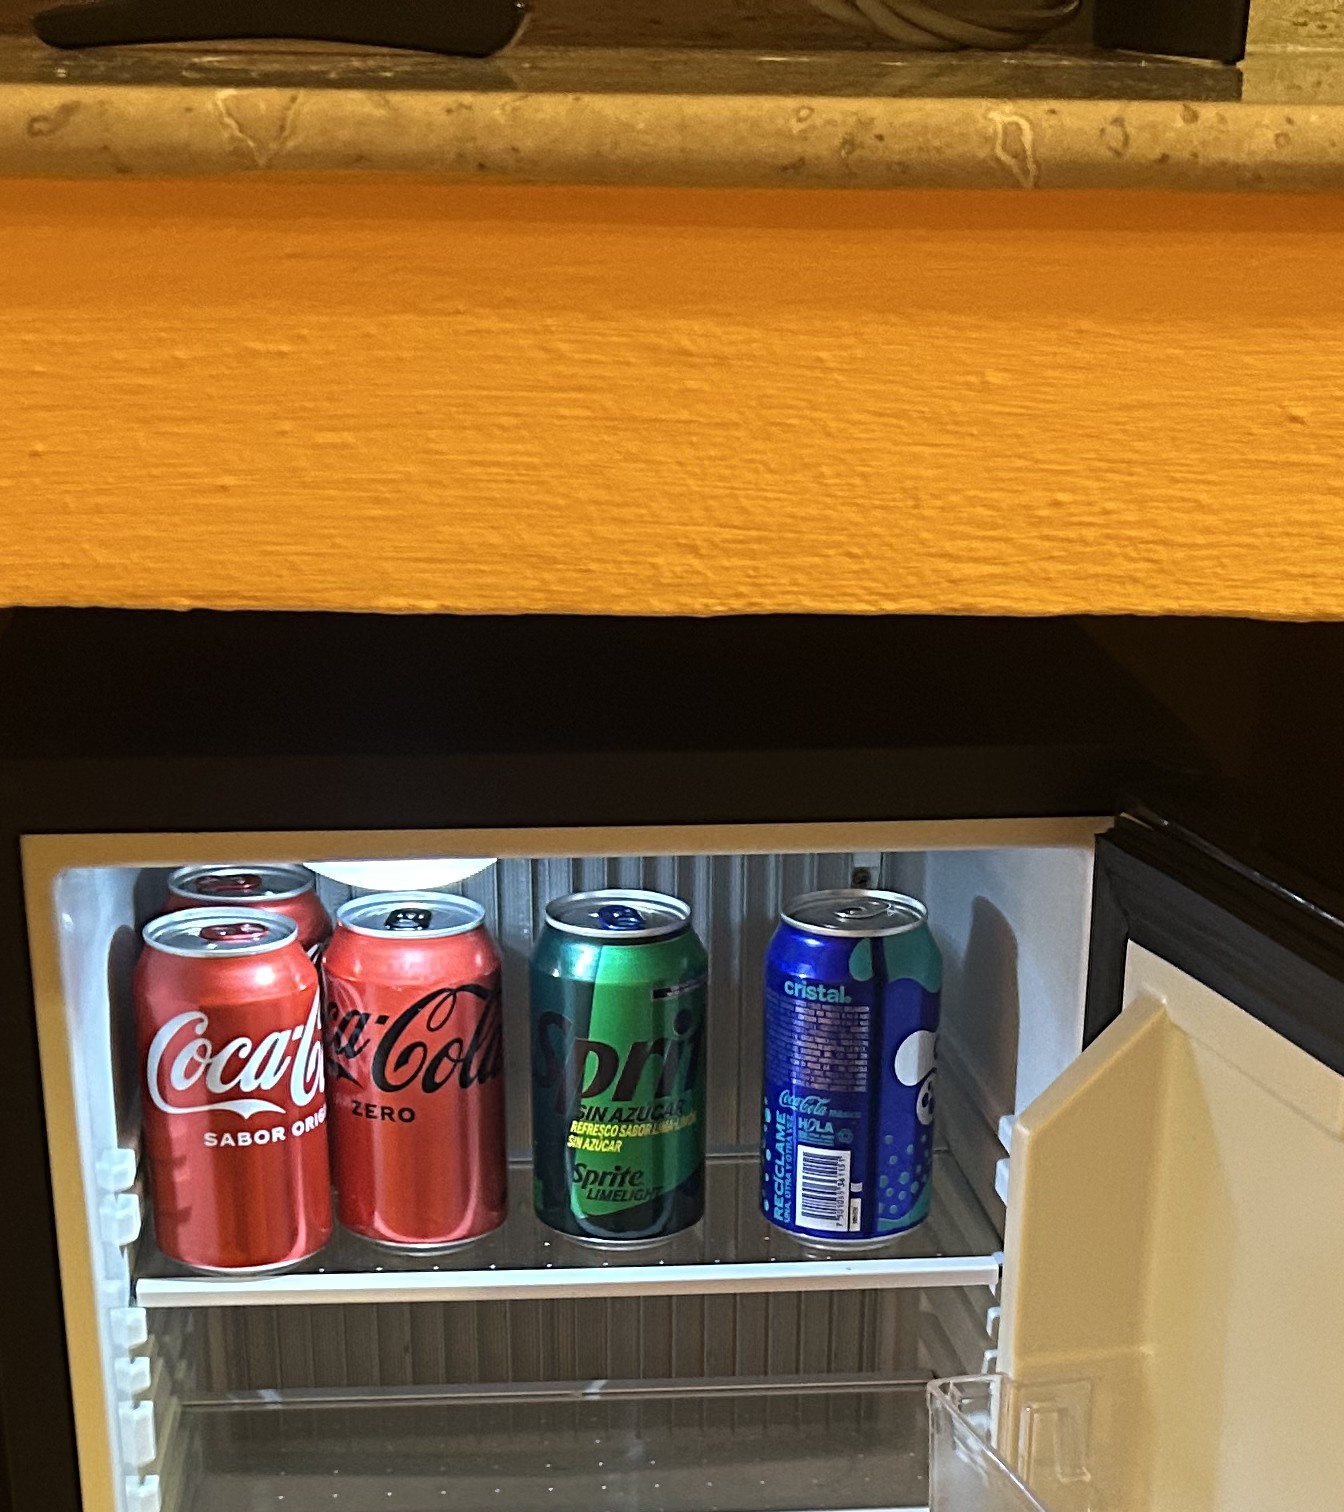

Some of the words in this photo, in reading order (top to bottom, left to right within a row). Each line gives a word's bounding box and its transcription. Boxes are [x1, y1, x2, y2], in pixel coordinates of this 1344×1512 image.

[147, 984, 325, 1120] Coca-C
[352, 1100, 416, 1123] ZERO
[578, 1104, 608, 1121] SIN
[570, 1120, 618, 1137] REFRESCO
[619, 1122, 653, 1138] SABOR
[798, 1117, 834, 1133] HOLA
[204, 1127, 286, 1147] SABOR
[567, 1135, 583, 1148] SIN
[573, 1163, 644, 1189] Sprite
